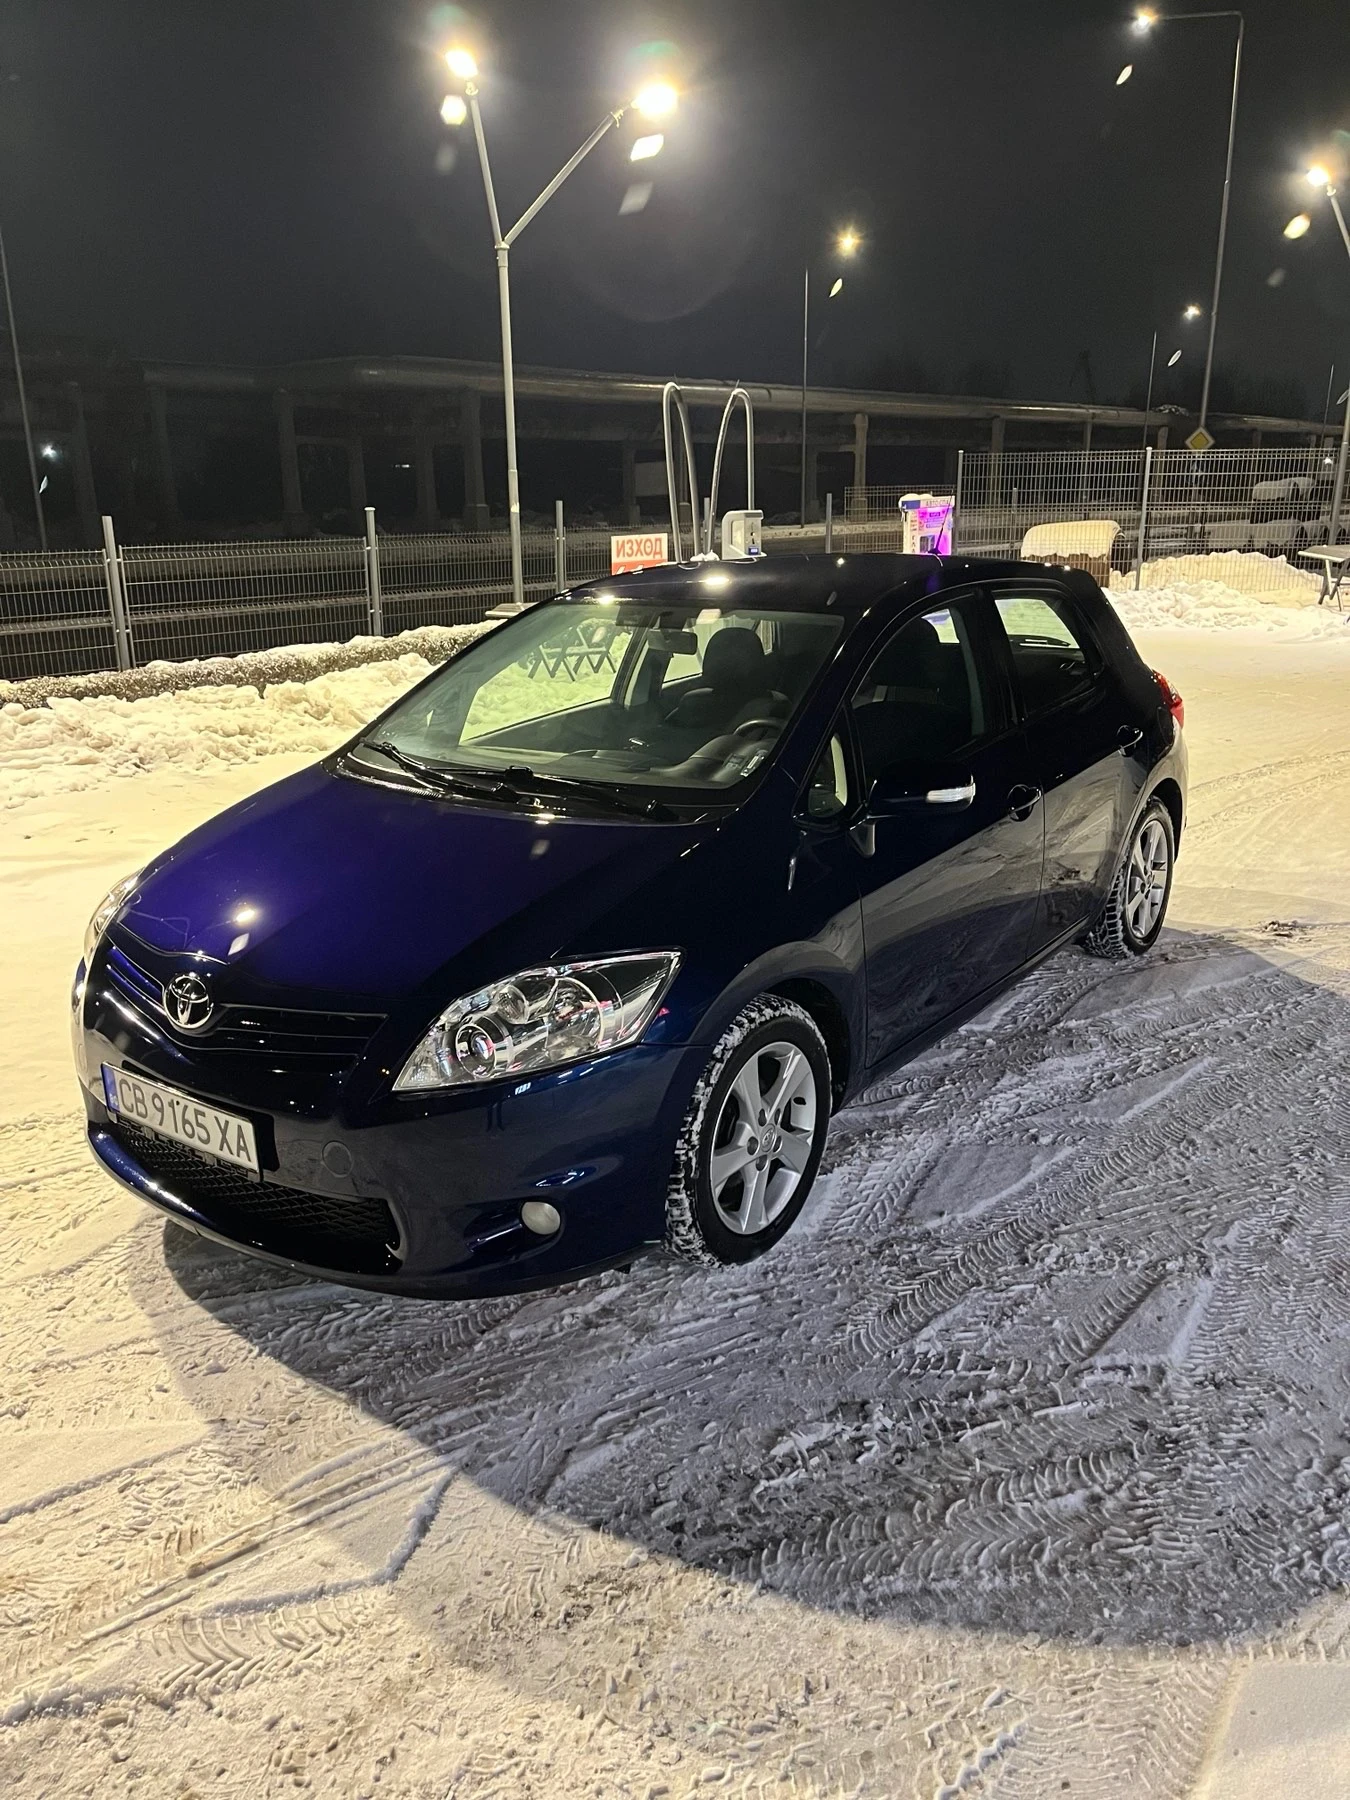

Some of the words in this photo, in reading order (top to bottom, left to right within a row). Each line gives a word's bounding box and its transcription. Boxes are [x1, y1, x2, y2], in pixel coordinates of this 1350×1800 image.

[616, 538, 663, 558] ИЗХОД
[119, 1078, 148, 1119] CB
[151, 1092, 211, 1145] 9165
[214, 1116, 252, 1162] XA
